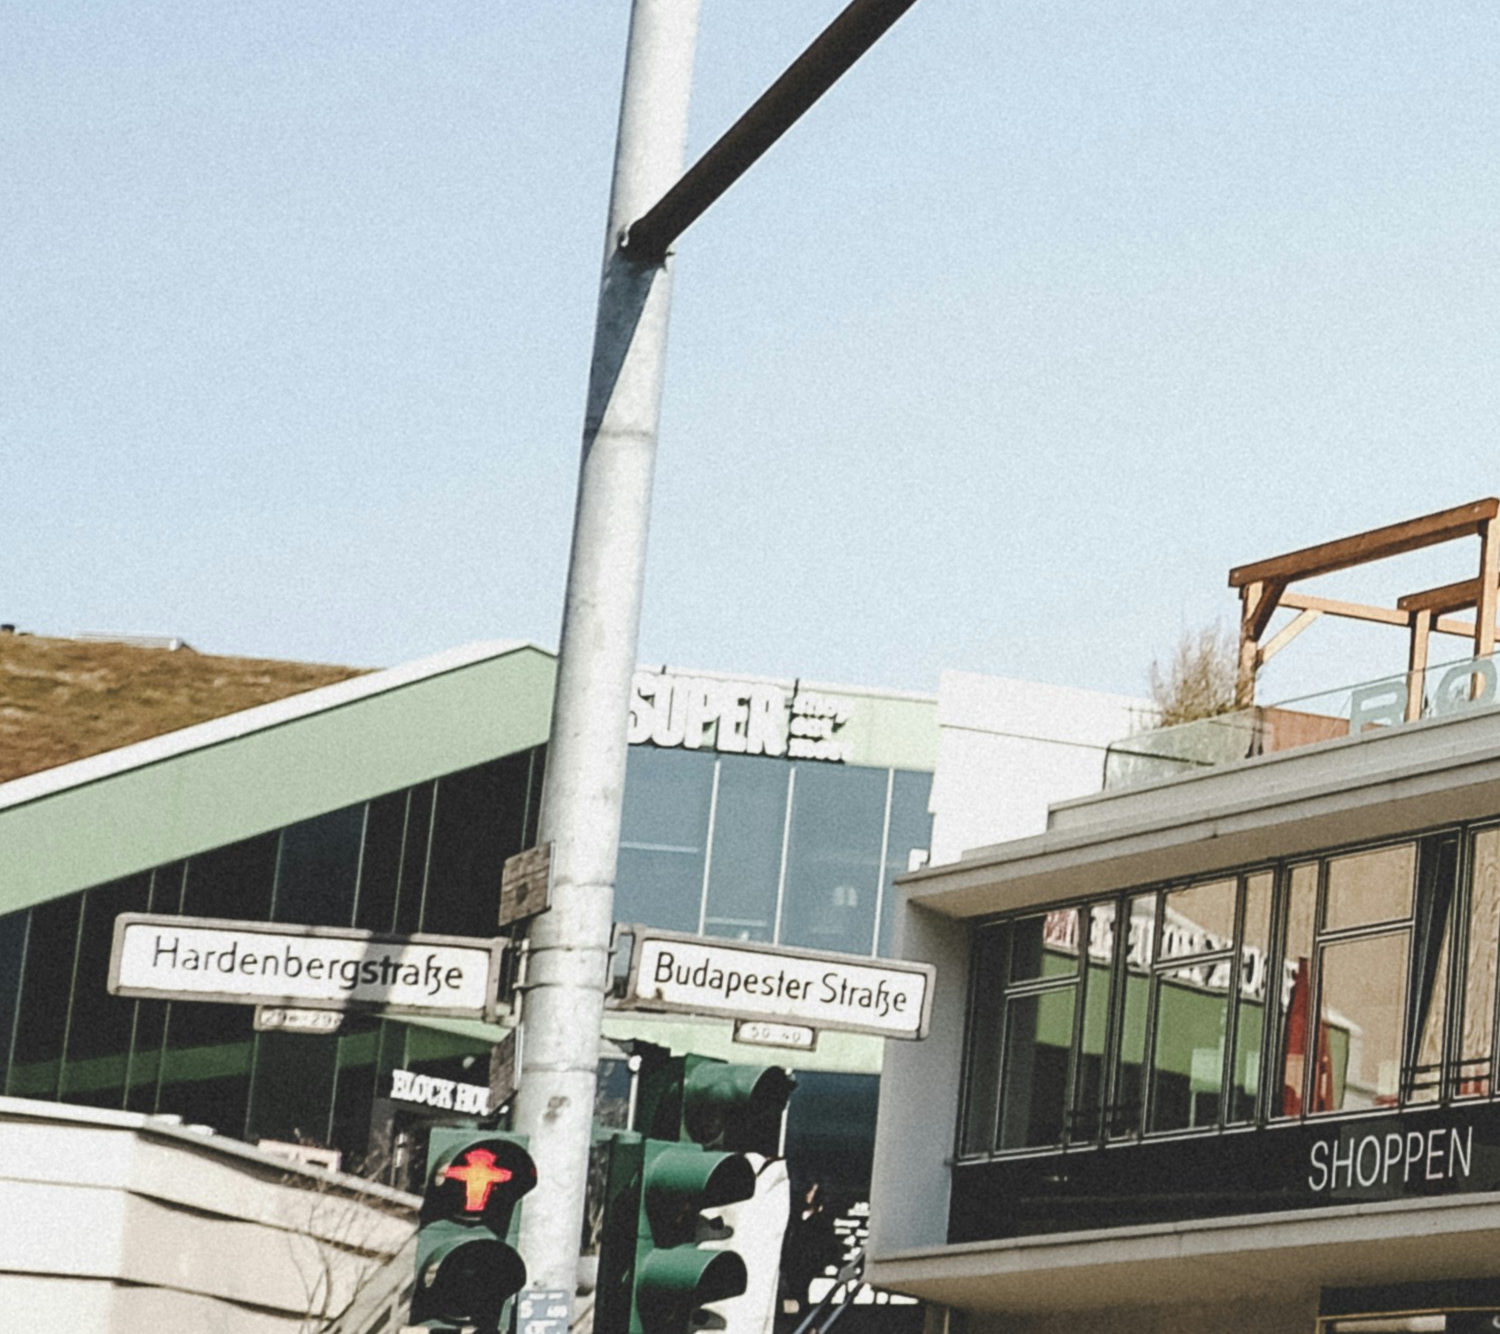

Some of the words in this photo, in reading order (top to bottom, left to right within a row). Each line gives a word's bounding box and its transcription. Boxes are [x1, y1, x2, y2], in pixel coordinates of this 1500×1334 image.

[628, 671, 786, 757] SUPER
[151, 935, 464, 997] Hardenbergstraße
[654, 951, 813, 1000] Budapester
[820, 972, 907, 1017] Straße
[1308, 1125, 1474, 1193] SHOPPEN
